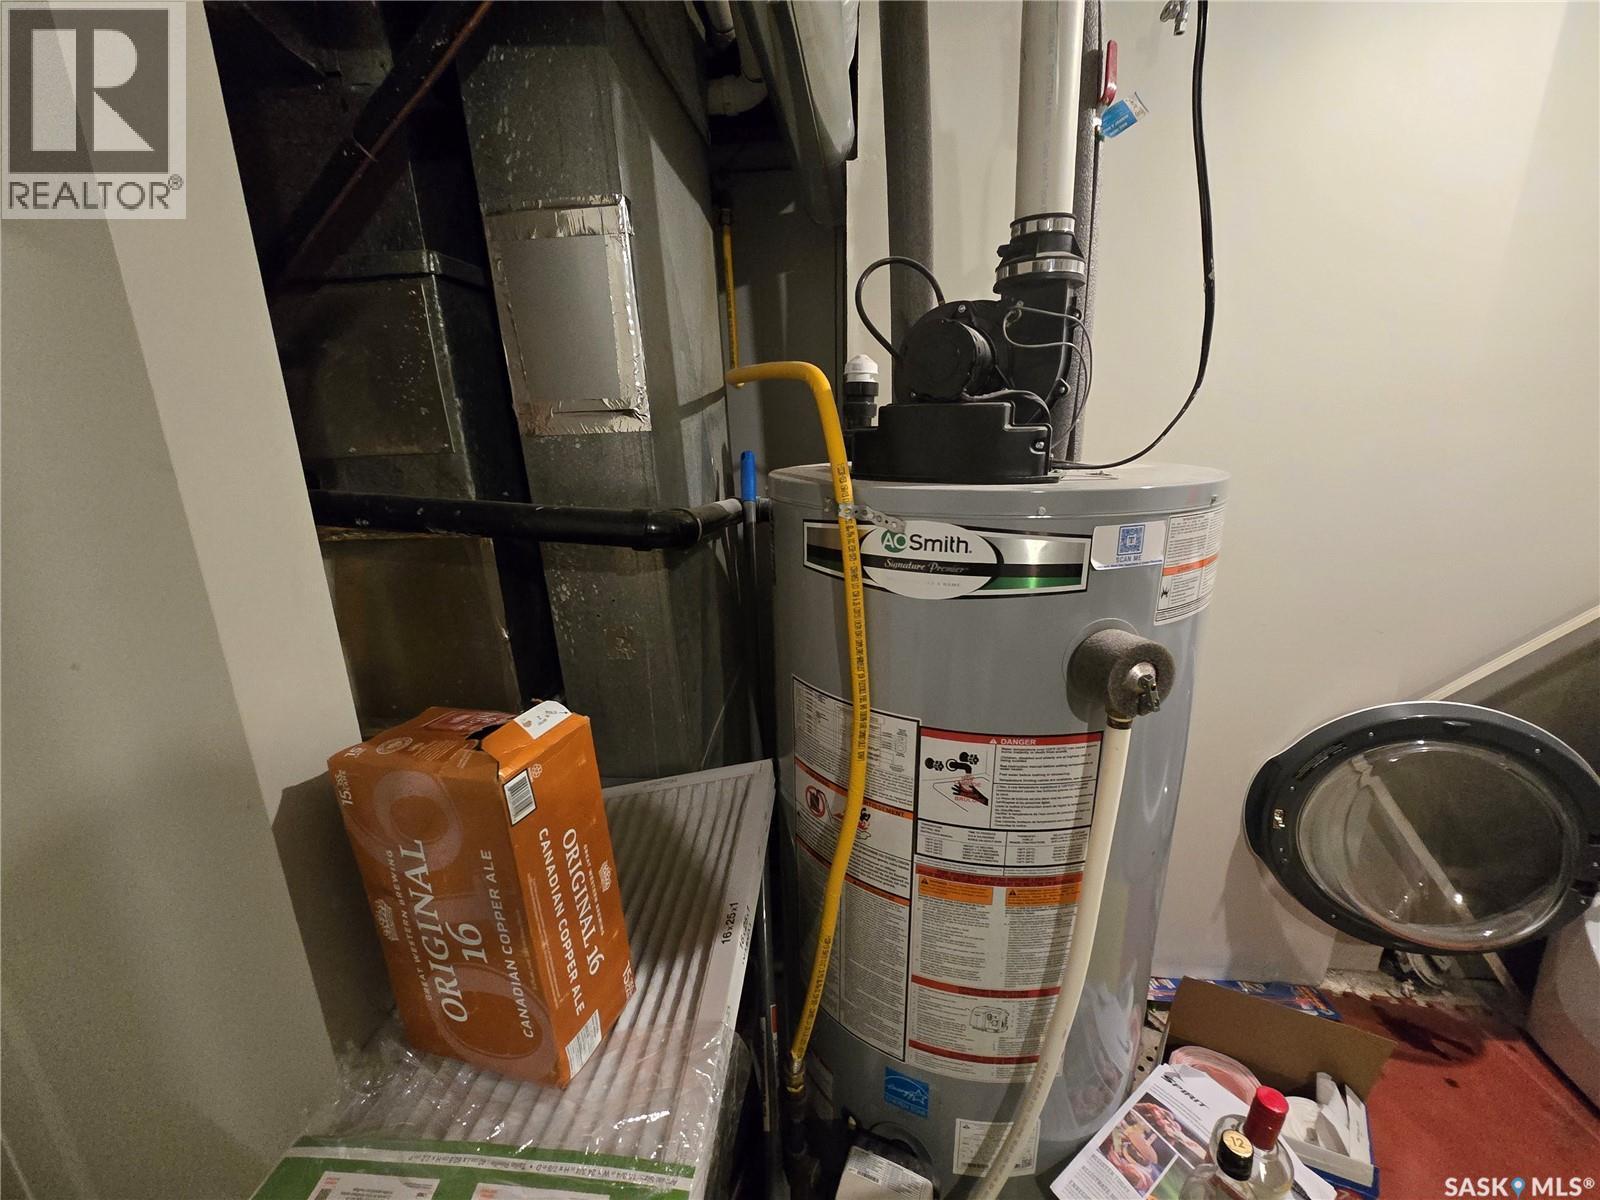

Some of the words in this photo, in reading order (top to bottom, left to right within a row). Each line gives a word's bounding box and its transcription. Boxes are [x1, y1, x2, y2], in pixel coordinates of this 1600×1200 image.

[884, 558, 926, 571] Signature
[1000, 738, 1037, 746] DANGER
[386, 849, 405, 906] BREWING
[480, 849, 499, 884] ALE
[490, 888, 513, 953] COPPER
[538, 827, 565, 919] CANADIAN
[558, 917, 580, 983] COPPER
[571, 982, 585, 1016] ALE
[562, 828, 590, 949] ORIGINAL
[585, 944, 605, 976] 16
[721, 901, 739, 945] 16x25x1
[399, 839, 469, 1022] ORIGINAL
[401, 909, 421, 964] WESTERN
[446, 921, 489, 964] 16
[417, 967, 433, 1001] GREAT
[510, 958, 534, 1039] CANADIAN
[1228, 1136, 1246, 1149] 12
